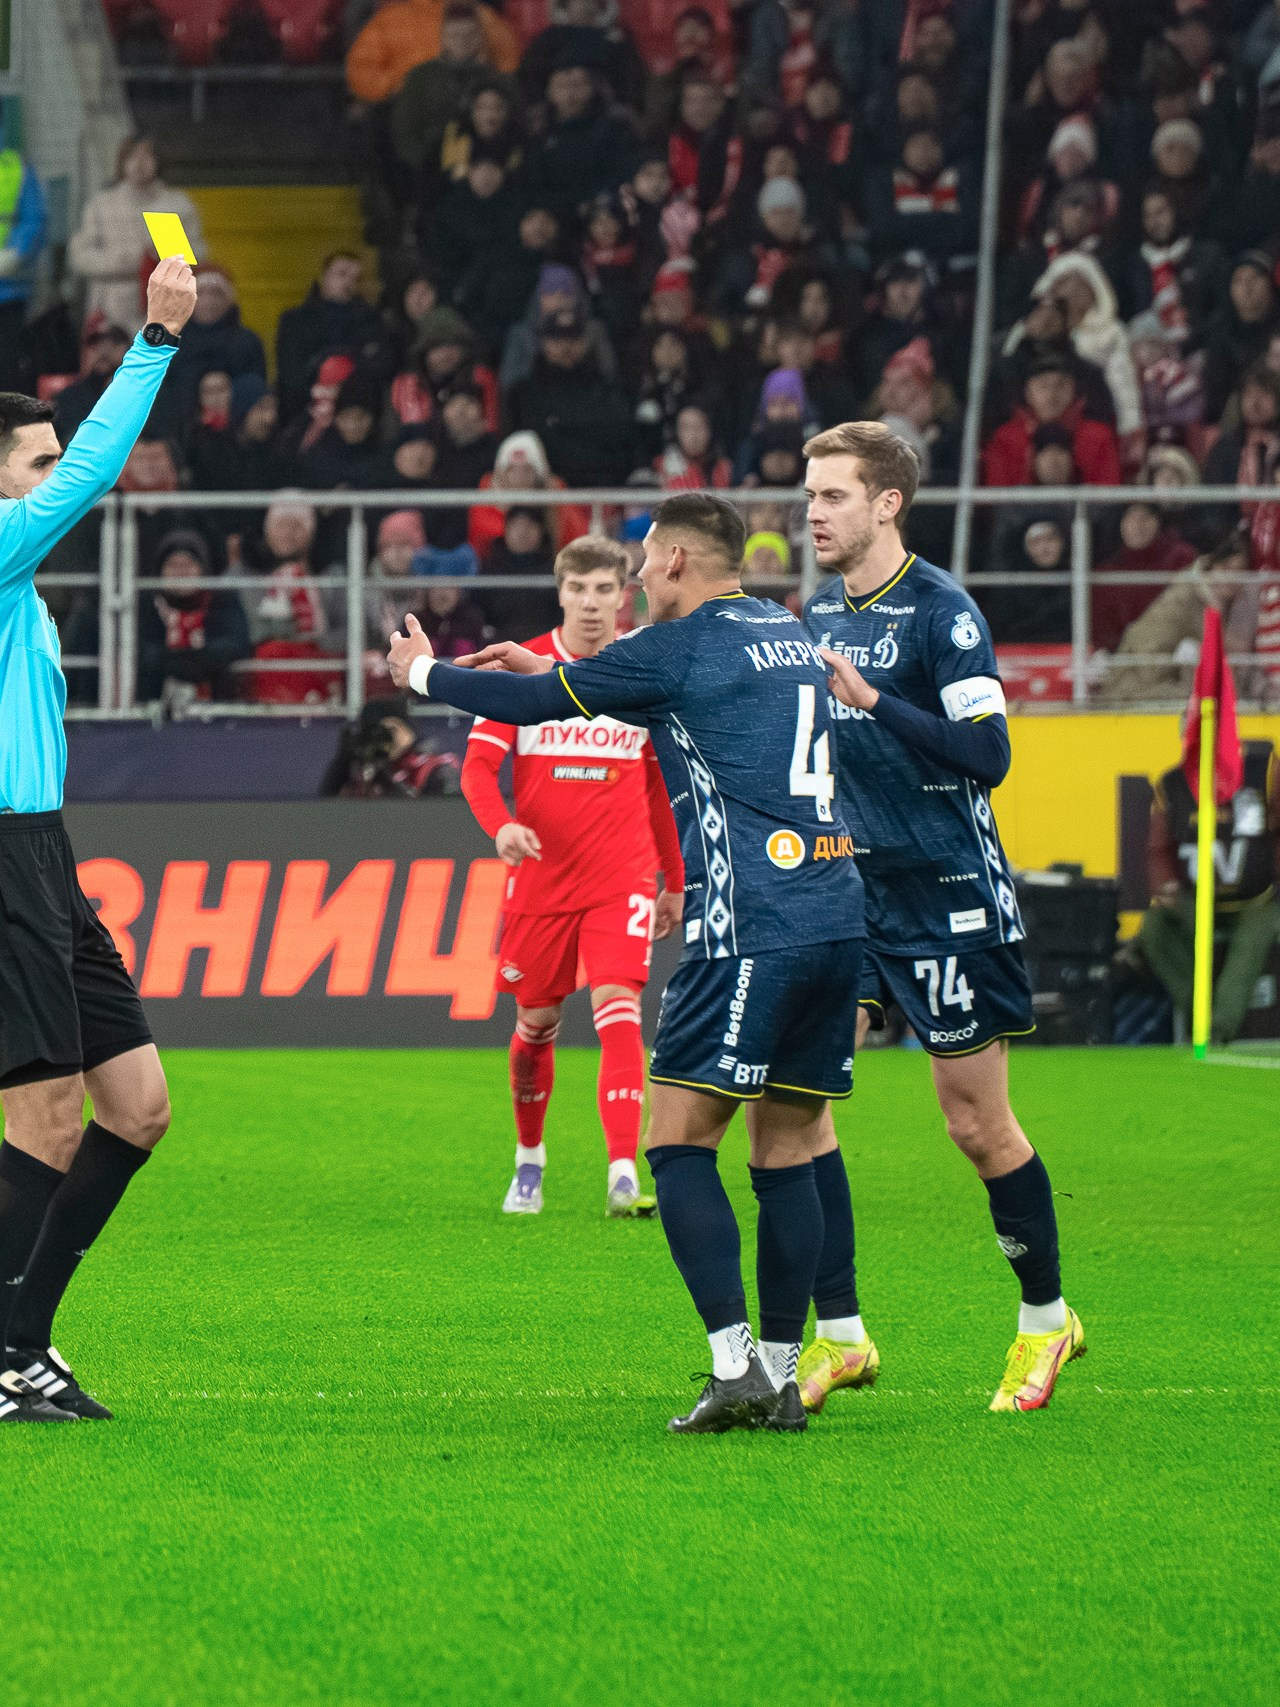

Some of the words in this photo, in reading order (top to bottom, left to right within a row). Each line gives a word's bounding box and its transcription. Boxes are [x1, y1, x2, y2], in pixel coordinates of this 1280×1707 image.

[539, 724, 639, 750] ЛУКОЙЛ
[789, 684, 835, 822] 4
[553, 766, 609, 781] WINLINE
[813, 836, 854, 861] ДИК
[914, 956, 975, 1017] 74
[723, 958, 755, 1048] BetBoom
[930, 1027, 975, 1043] BOSCO
